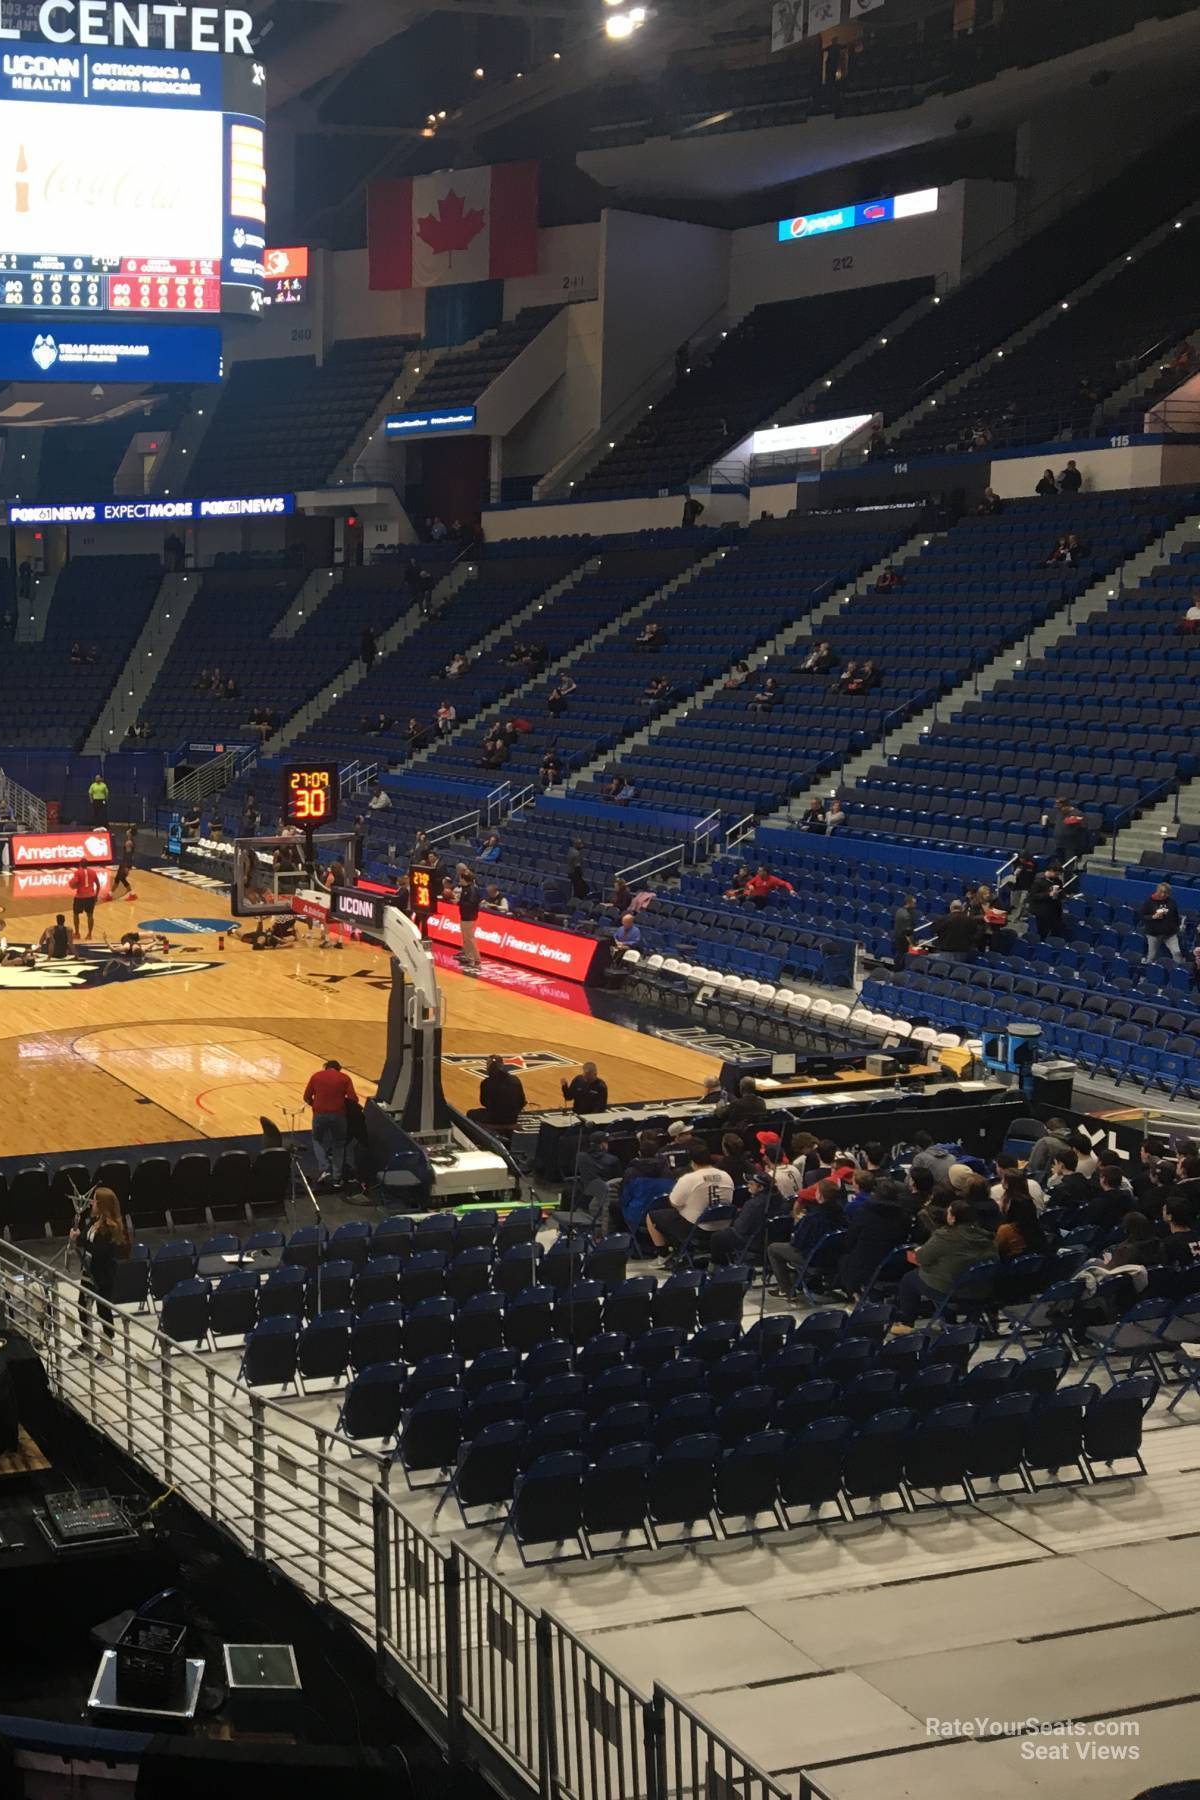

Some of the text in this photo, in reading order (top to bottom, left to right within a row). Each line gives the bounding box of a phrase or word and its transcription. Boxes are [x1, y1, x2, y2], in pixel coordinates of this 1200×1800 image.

[38, 0, 255, 54] CENTER
[3, 54, 80, 78] UCONN
[12, 77, 72, 92] HEALTH
[833, 256, 854, 271] 212
[1110, 435, 1130, 447] 115
[894, 463, 907, 474] 114
[290, 772, 329, 788] 27:09
[296, 790, 325, 817] 30
[16, 843, 85, 861] Ameritas
[417, 888, 429, 906] 30
[338, 896, 373, 919] UCONN
[474, 927, 501, 944] Benefits
[505, 935, 539, 954] Financial
[539, 943, 572, 964] Services
